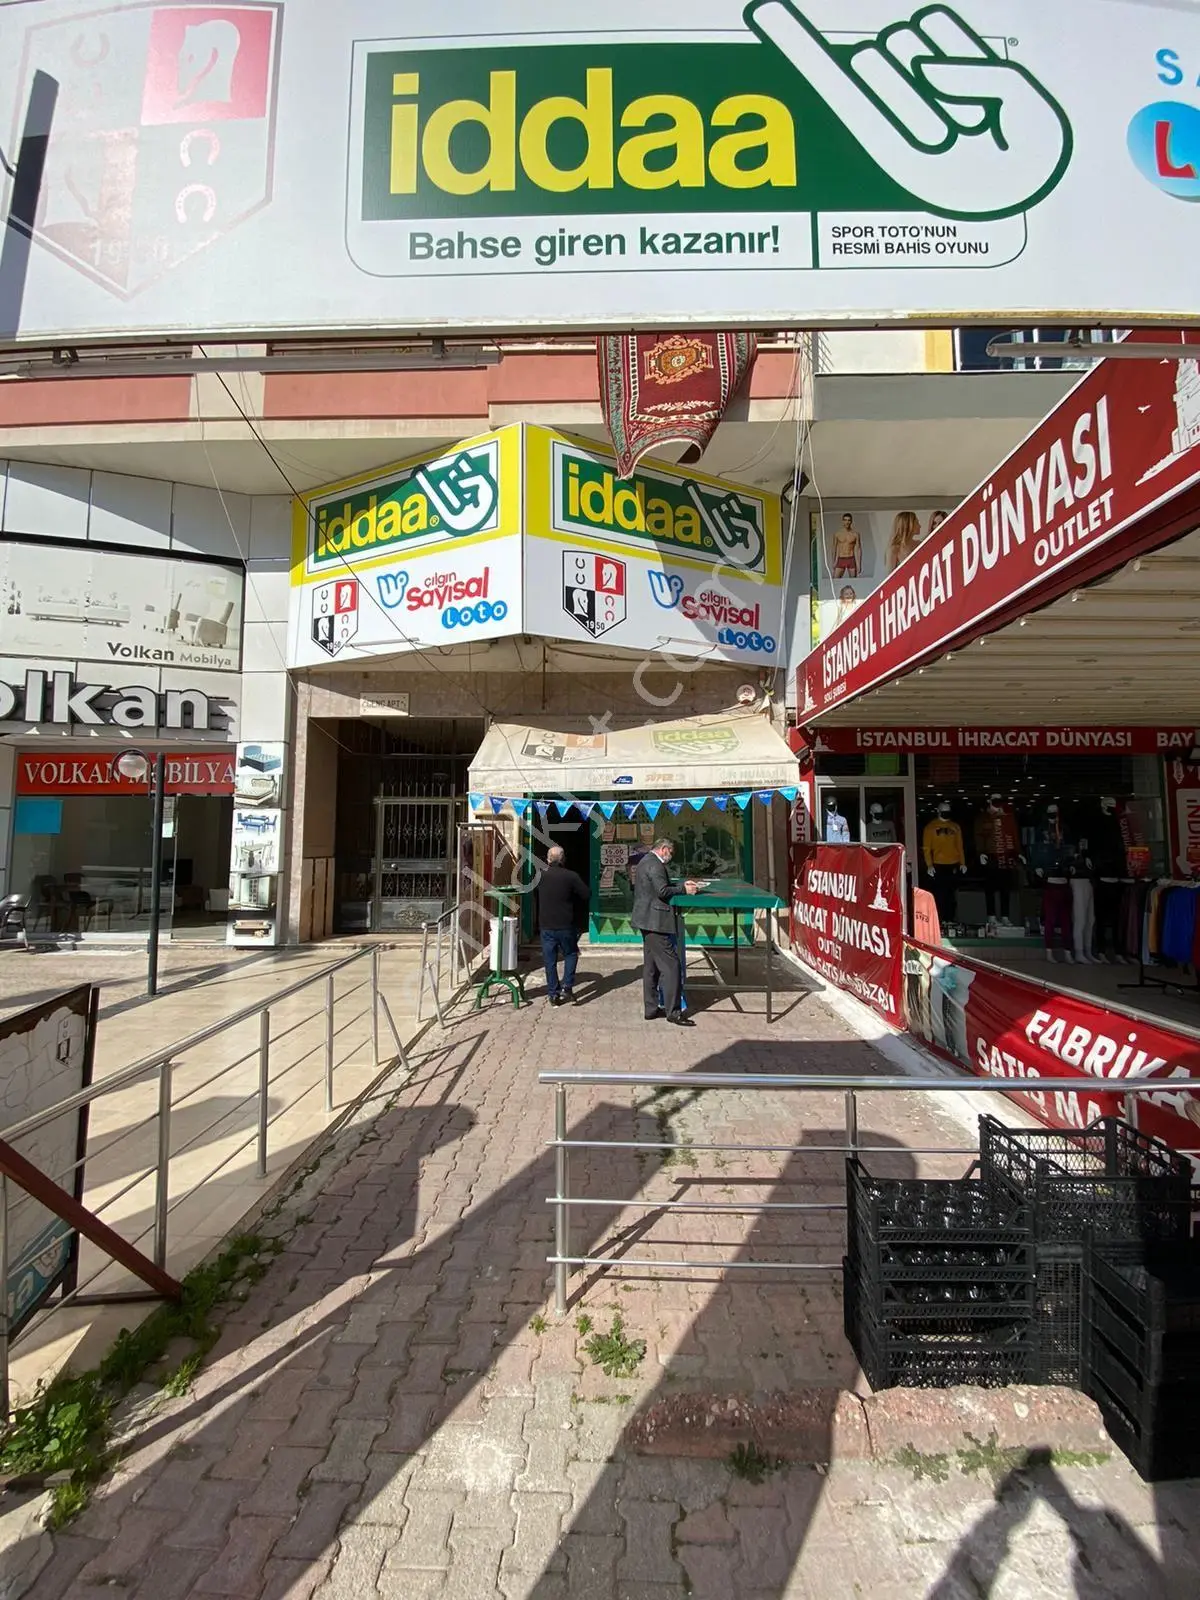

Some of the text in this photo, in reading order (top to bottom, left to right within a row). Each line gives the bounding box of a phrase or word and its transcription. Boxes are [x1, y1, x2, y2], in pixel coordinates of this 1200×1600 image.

[1155, 48, 1200, 88] S
[389, 66, 797, 196] iddaa
[409, 225, 780, 266] Bahse giren kazanır!
[831, 225, 957, 239] SPOR TOTO'NUN
[832, 239, 989, 255] RESMİ BAHİS OYUNU
[568, 462, 701, 545] iddaa
[317, 493, 429, 557] iddaa
[823, 395, 1113, 690] İSTANBUL İHRACAT DÜNYASI
[1033, 487, 1114, 567] OUTLET
[585, 619, 606, 632] 1950
[107, 641, 232, 667] Volkan Mobilya
[856, 728, 1194, 747] İSTANBUL İHRACAT DÜNYASI BAY
[24, 762, 122, 785] VOLKAN
[807, 864, 858, 903] İSTANBUL
[832, 907, 892, 958] DÜNYASI
